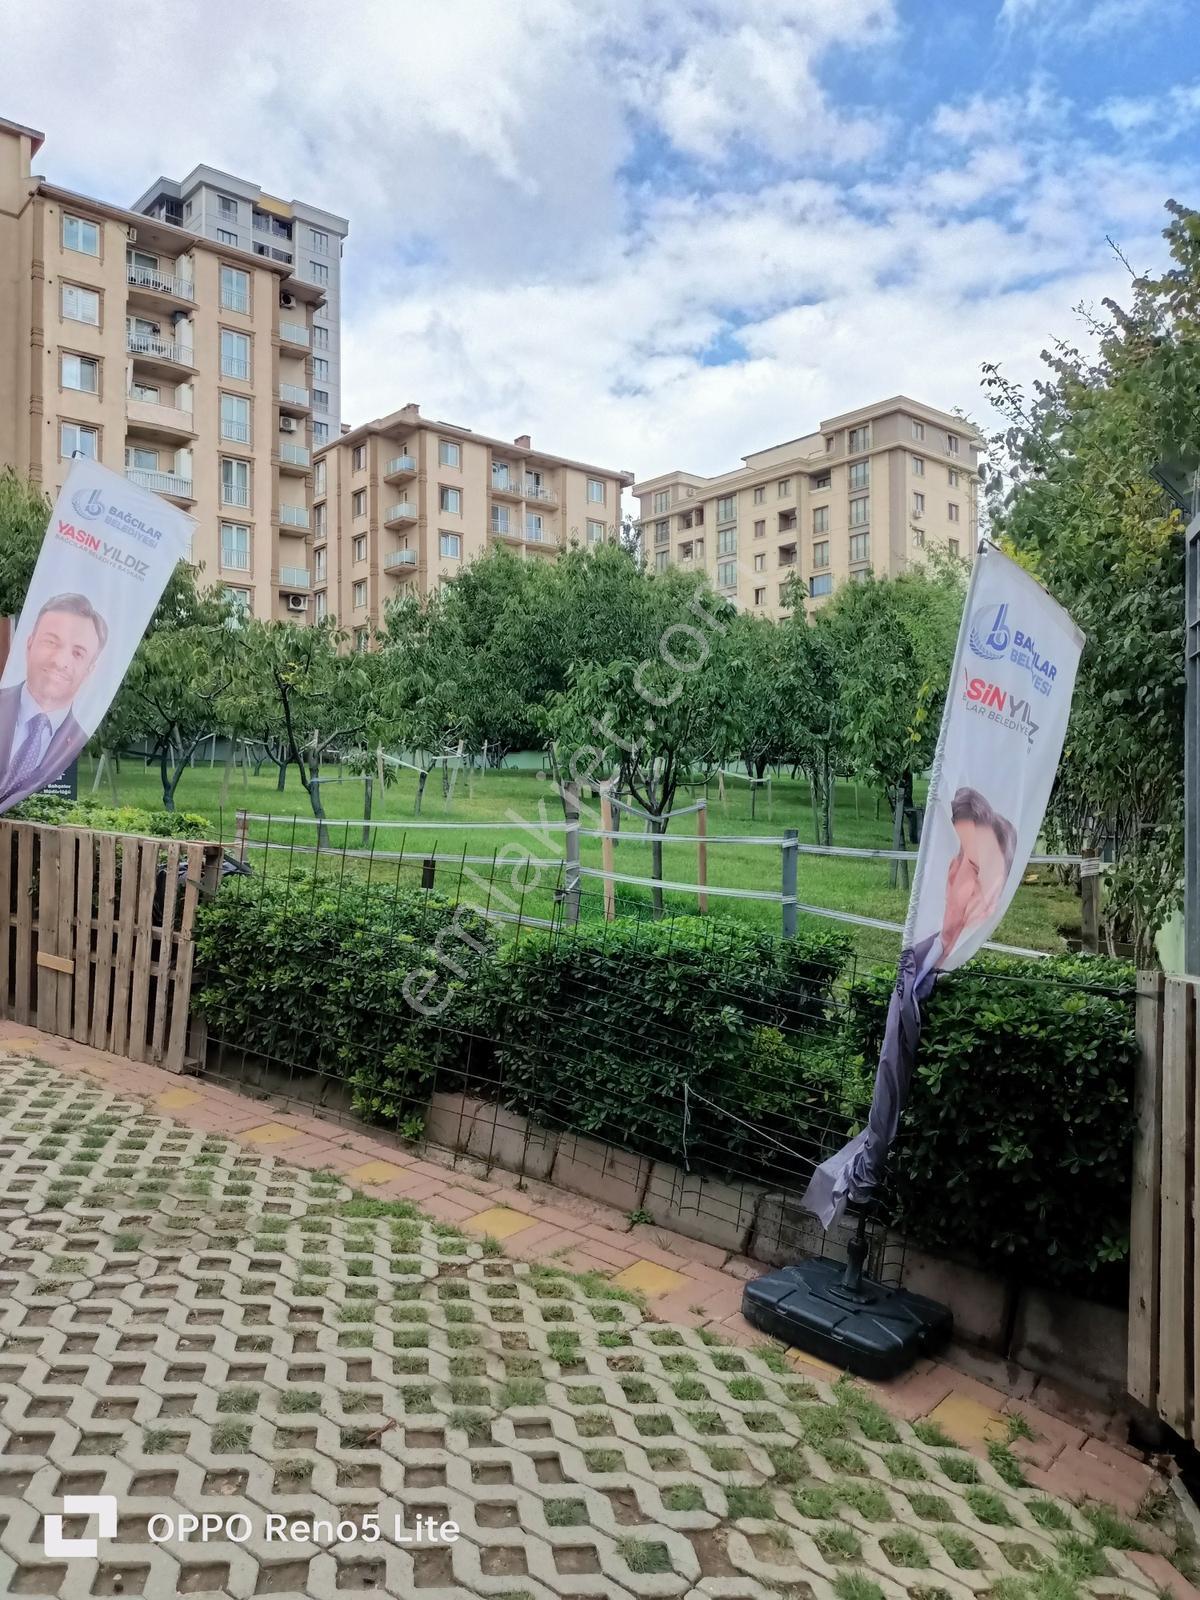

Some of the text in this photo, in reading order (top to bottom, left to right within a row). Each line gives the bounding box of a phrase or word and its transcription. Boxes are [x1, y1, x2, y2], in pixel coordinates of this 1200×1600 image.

[103, 515, 159, 549] BELEDİYESİ
[108, 505, 162, 540] BAĞCILAR
[103, 542, 150, 577] YILDIZ
